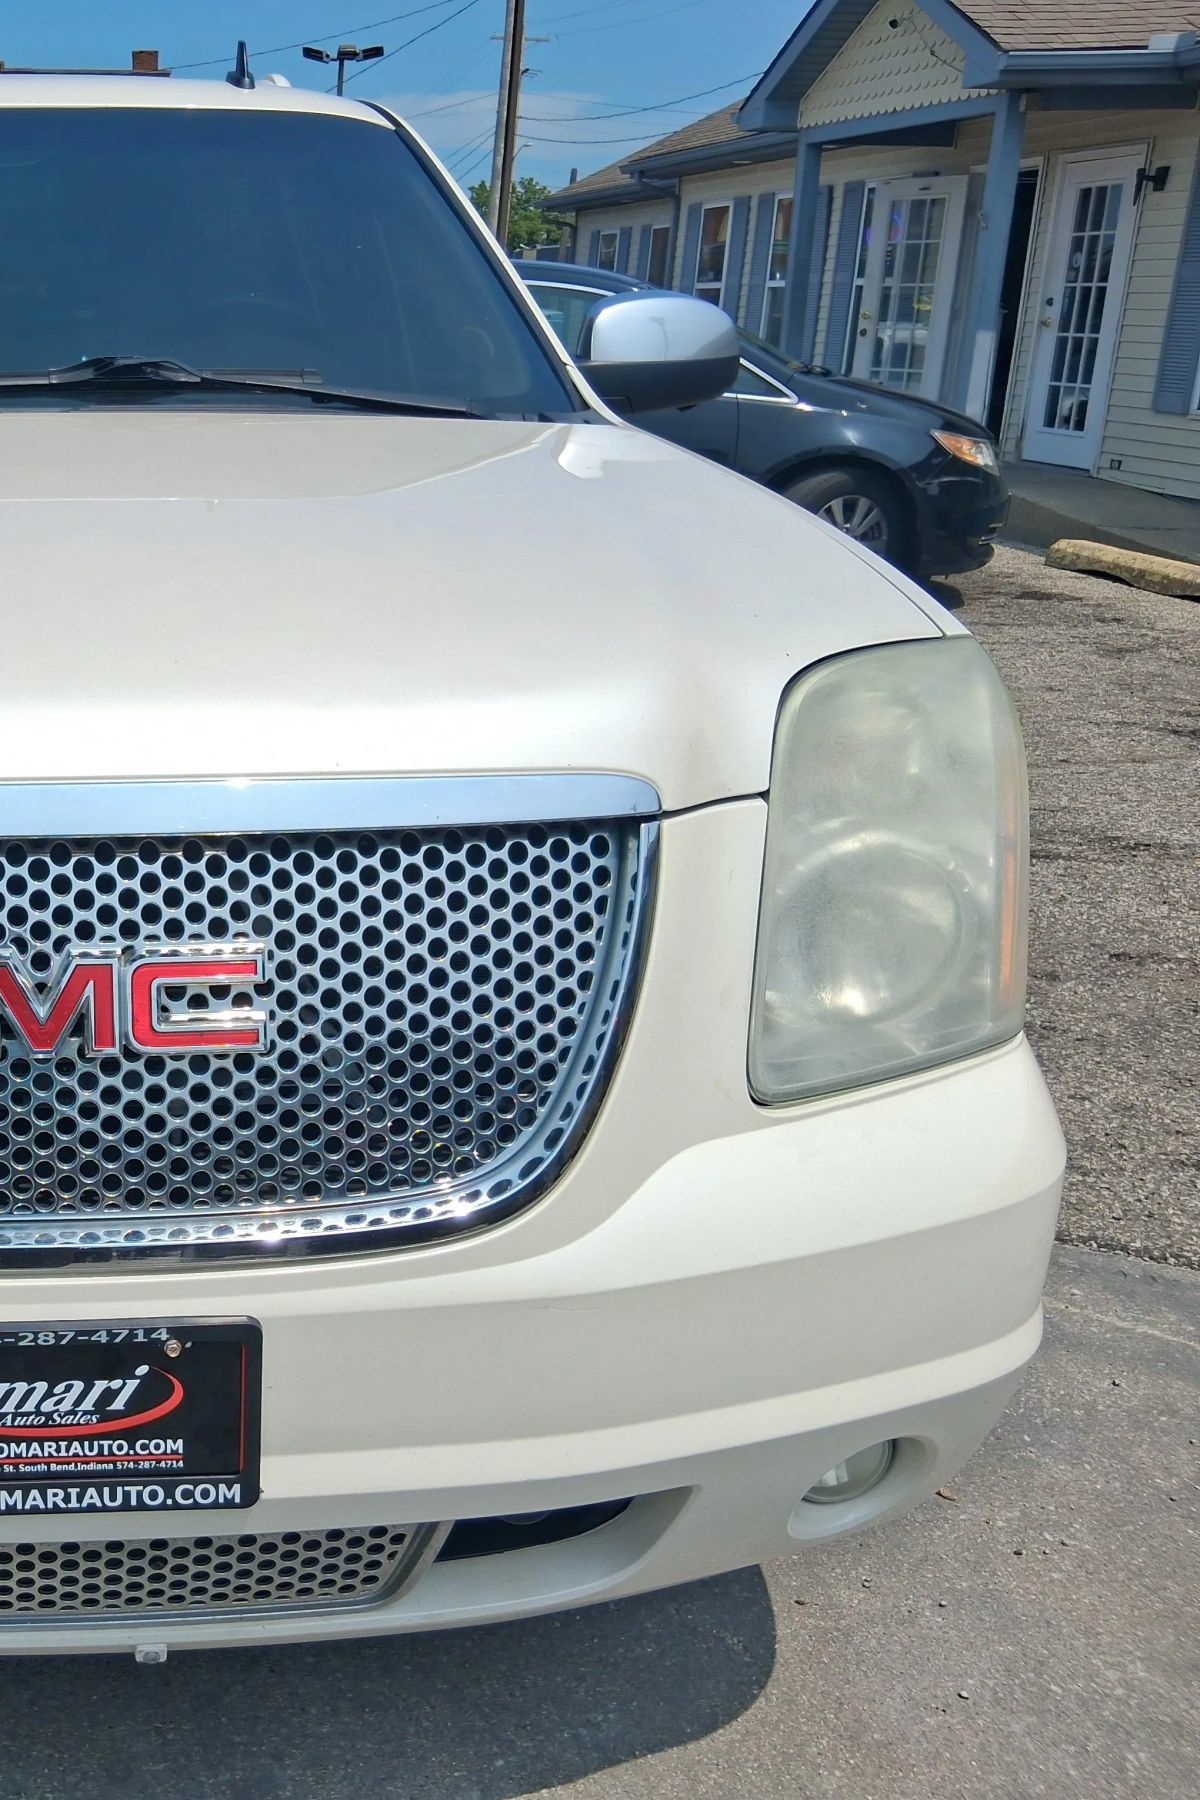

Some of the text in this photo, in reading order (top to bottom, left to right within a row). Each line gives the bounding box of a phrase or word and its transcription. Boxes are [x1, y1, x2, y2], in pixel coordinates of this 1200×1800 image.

[48, 1411, 100, 1425] Sales
[3, 1464, 16, 1473] St.
[19, 1463, 48, 1472] South
[116, 1460, 184, 1469] 574-287-4714
